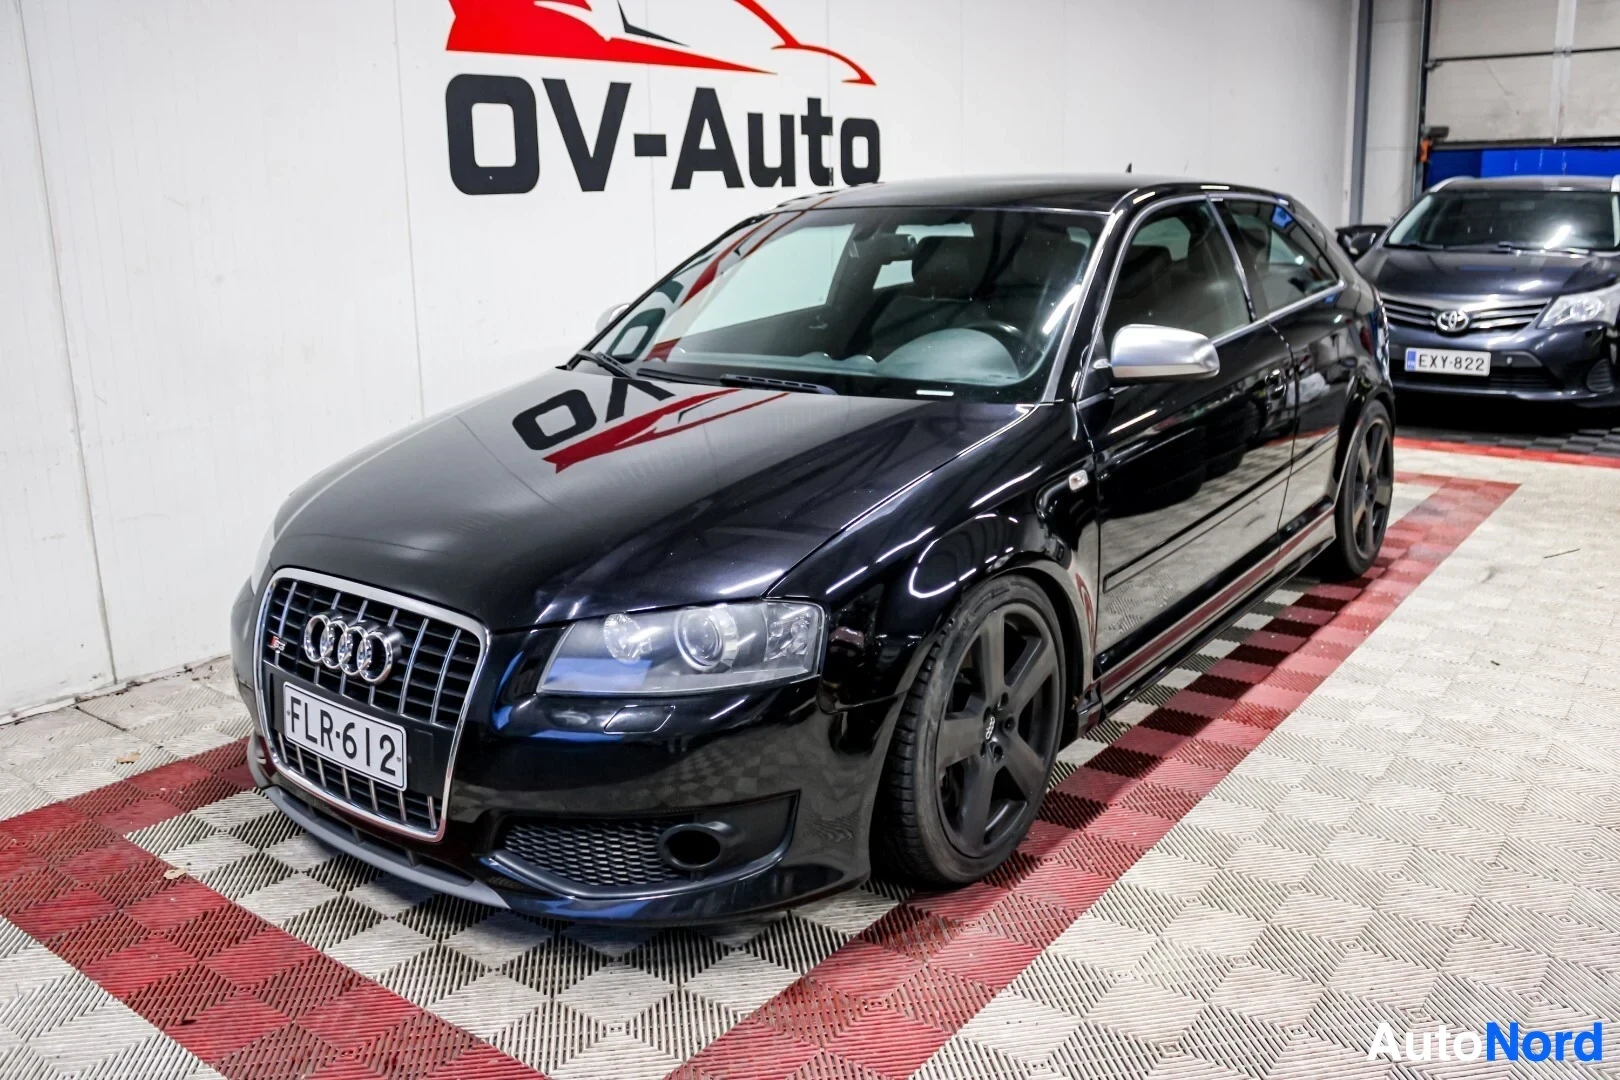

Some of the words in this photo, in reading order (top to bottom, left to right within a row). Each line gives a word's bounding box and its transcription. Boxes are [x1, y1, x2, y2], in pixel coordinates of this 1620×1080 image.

[445, 73, 881, 195] OV-Auto
[1418, 353, 1485, 371] EXY-822
[290, 696, 396, 776] FLR-612
